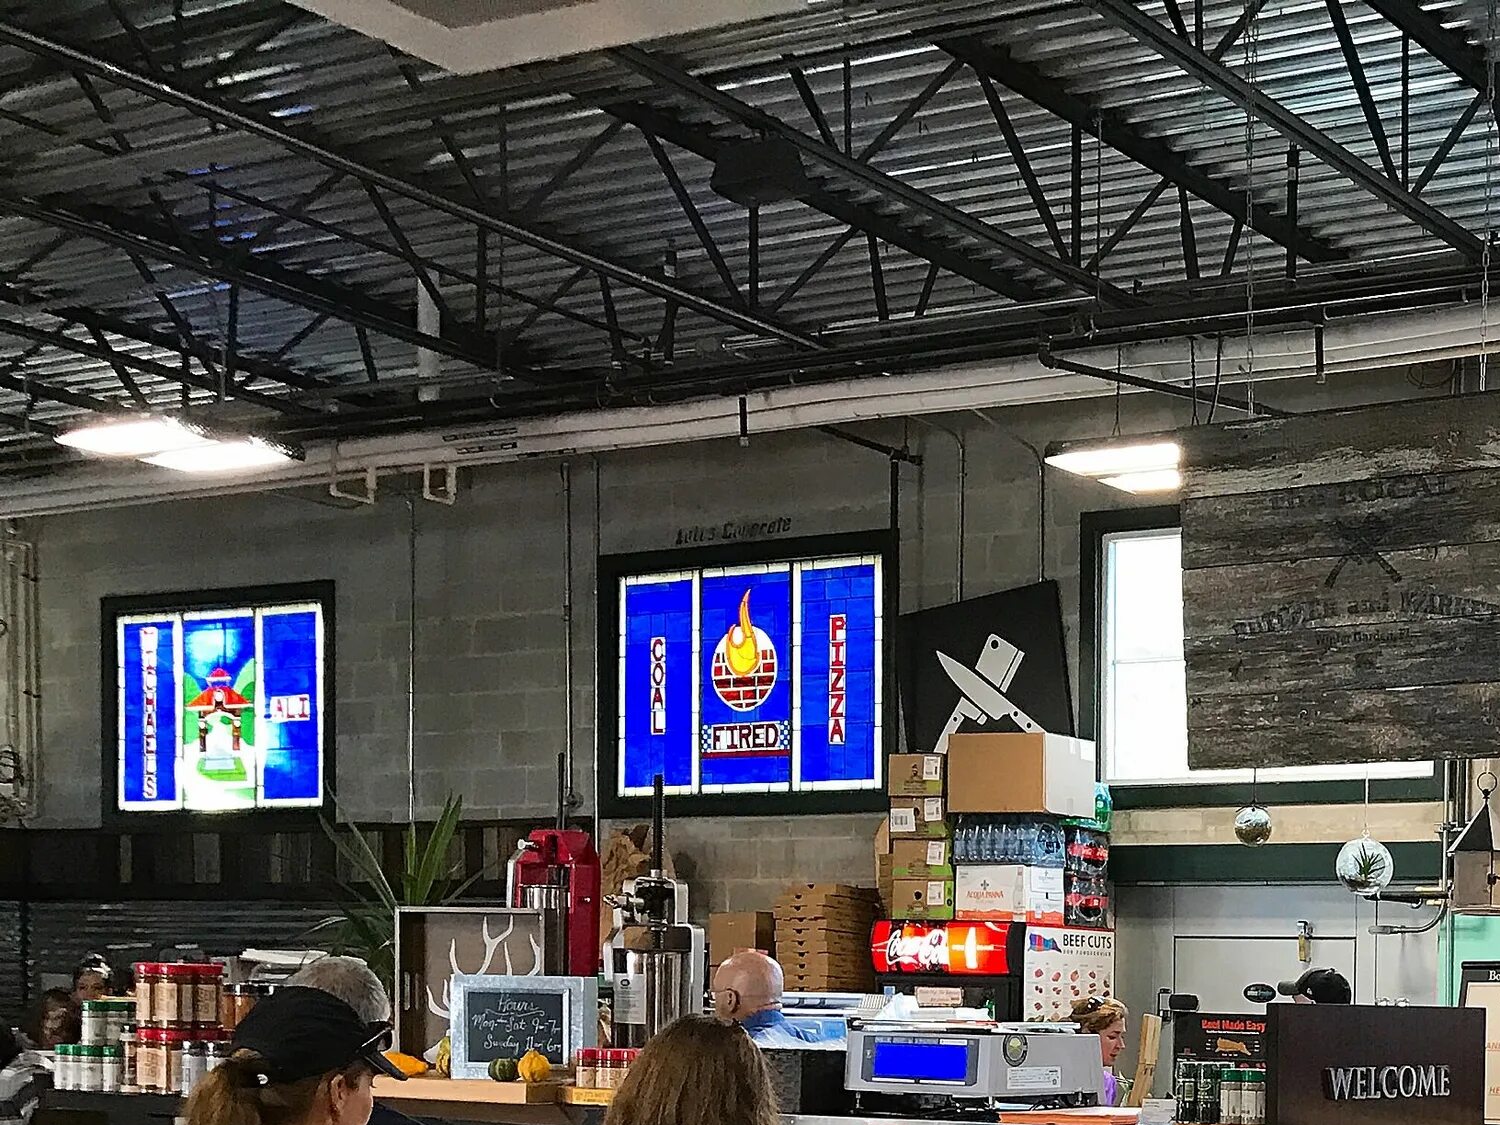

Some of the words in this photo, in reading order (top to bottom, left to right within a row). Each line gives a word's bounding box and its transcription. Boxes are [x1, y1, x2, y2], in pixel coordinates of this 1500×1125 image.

[652, 638, 665, 734] COAL
[830, 615, 846, 744] PIZZA
[275, 694, 308, 710] ALI
[712, 723, 780, 750] FIRED
[1063, 934, 1085, 947] BEEF
[1088, 935, 1111, 949] CUTS
[499, 995, 539, 1012] Hours
[1222, 1020, 1244, 1030] Made
[1246, 1020, 1266, 1033] Easy
[1327, 1064, 1450, 1100] WELCOME
